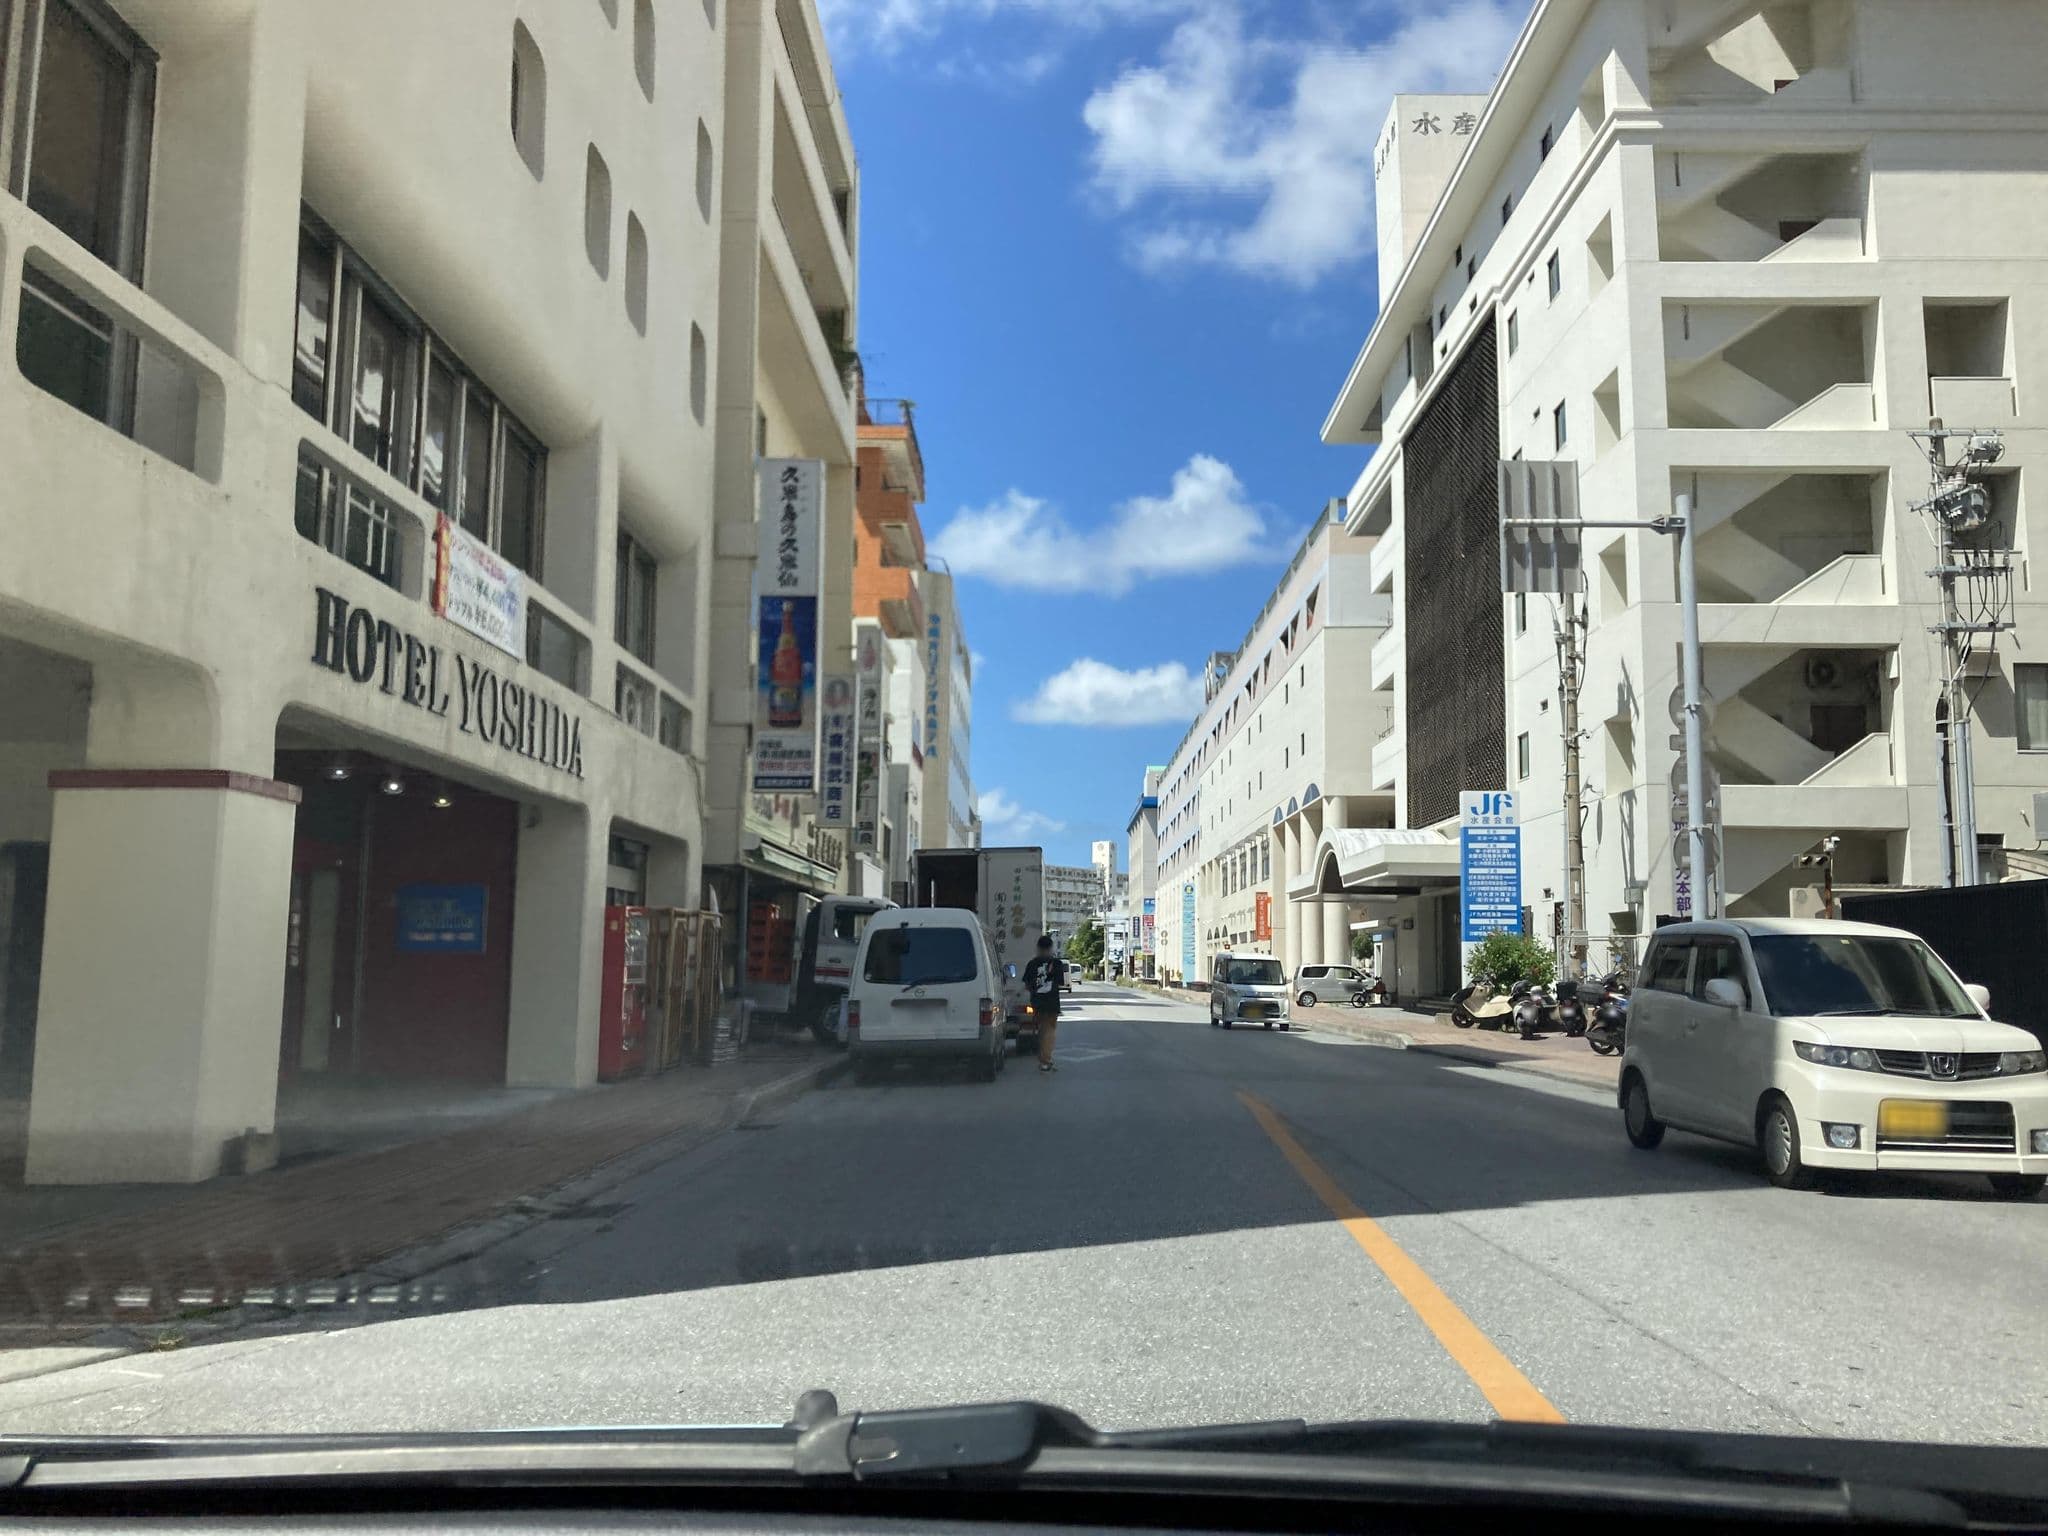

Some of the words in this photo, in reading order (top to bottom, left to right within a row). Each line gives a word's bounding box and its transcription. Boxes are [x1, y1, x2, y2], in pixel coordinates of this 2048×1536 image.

[311, 586, 449, 718] HOTEL
[456, 653, 584, 782] YOSHIDA
[1470, 792, 1513, 816] JF
